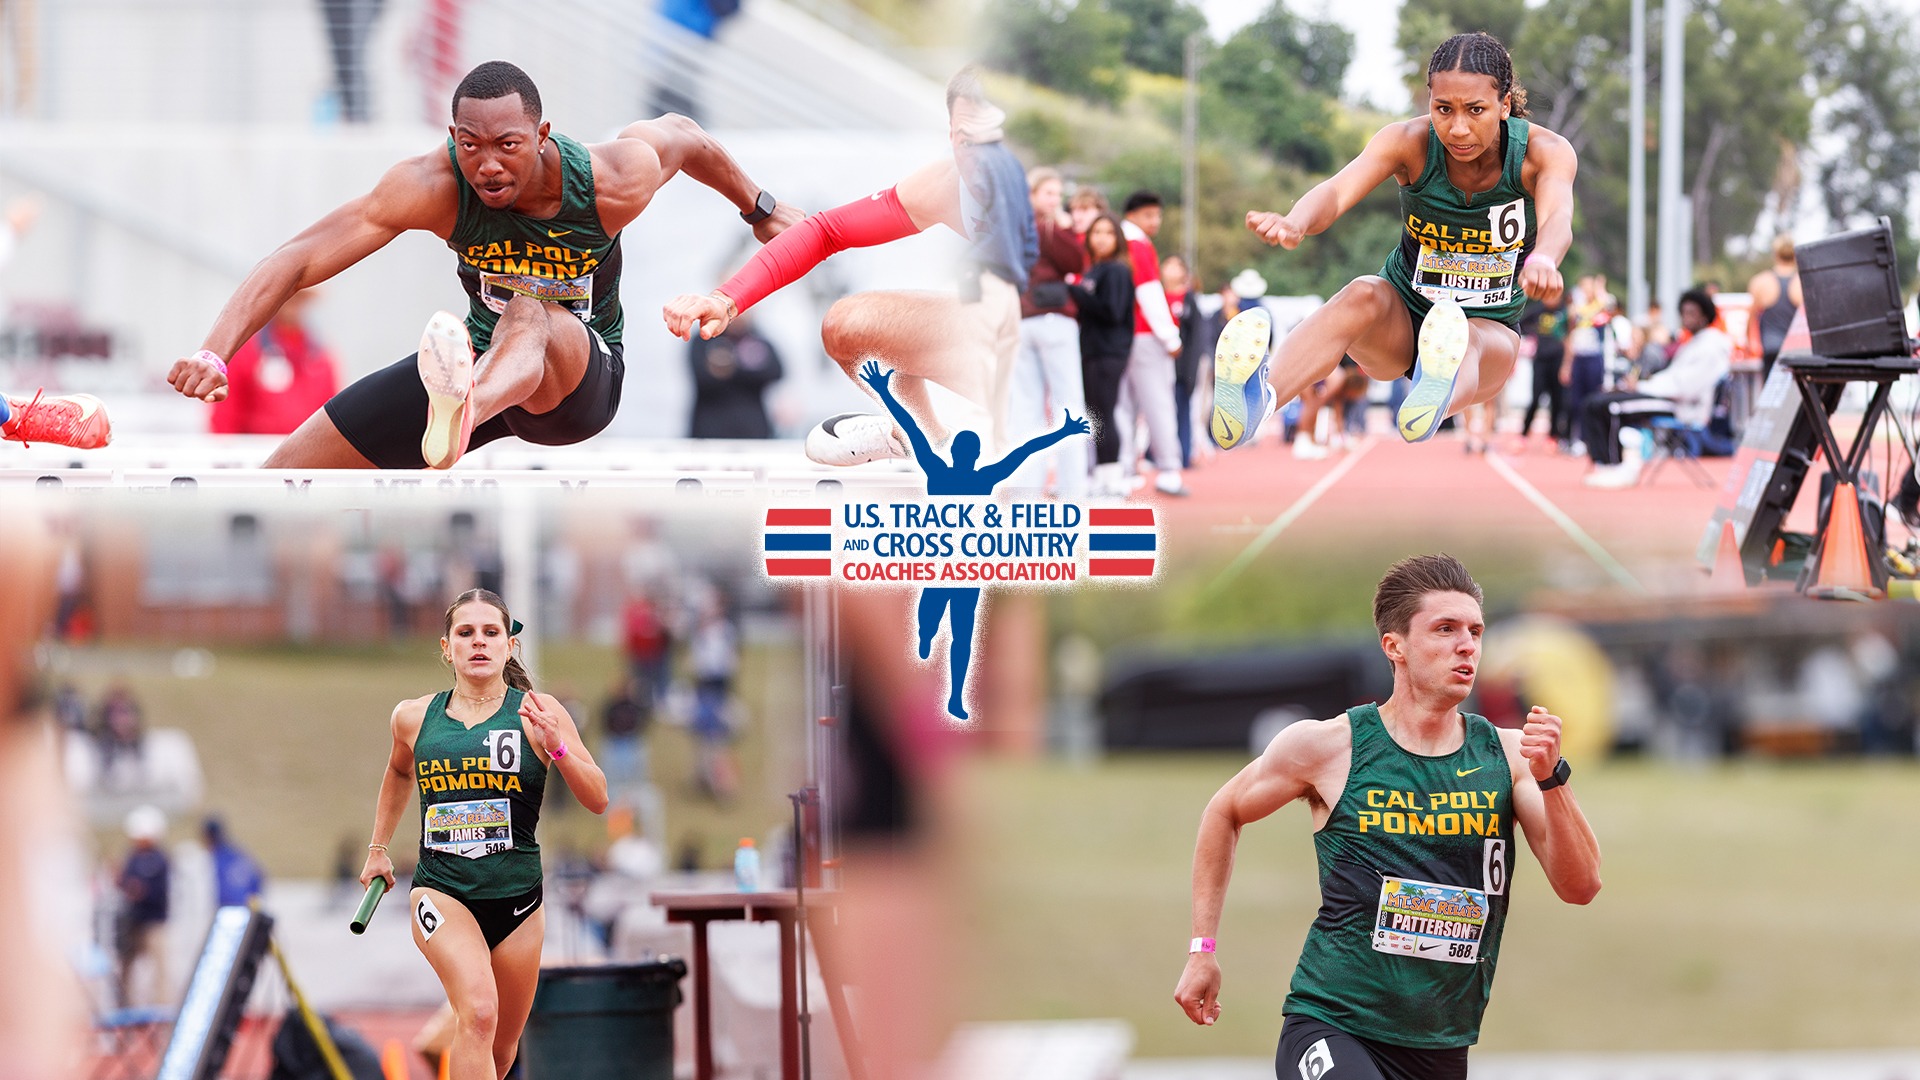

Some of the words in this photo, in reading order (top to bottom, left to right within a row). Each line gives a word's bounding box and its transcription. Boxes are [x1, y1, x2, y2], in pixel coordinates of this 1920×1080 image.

[1408, 214, 1455, 239] CAL
[1461, 227, 1492, 243] PO
[1499, 203, 1520, 245] 6
[467, 240, 520, 258] CAL
[1468, 261, 1512, 274] RELAYS
[1441, 273, 1491, 290] LUSTER
[496, 732, 516, 770] 6
[418, 758, 458, 776] CAL
[461, 756, 491, 771] PO
[418, 773, 523, 795] POMONA
[1367, 789, 1424, 810] CAL
[1428, 791, 1499, 811] POLY
[467, 811, 505, 824] RELAYS
[1357, 810, 1500, 837] POMONA
[449, 827, 486, 842] JAMES
[1489, 842, 1502, 892] 6
[418, 901, 438, 933] 6
[1437, 900, 1483, 919] RELAYS
[1392, 913, 1471, 939] PATTERSON
[1305, 1045, 1324, 1080] 6
